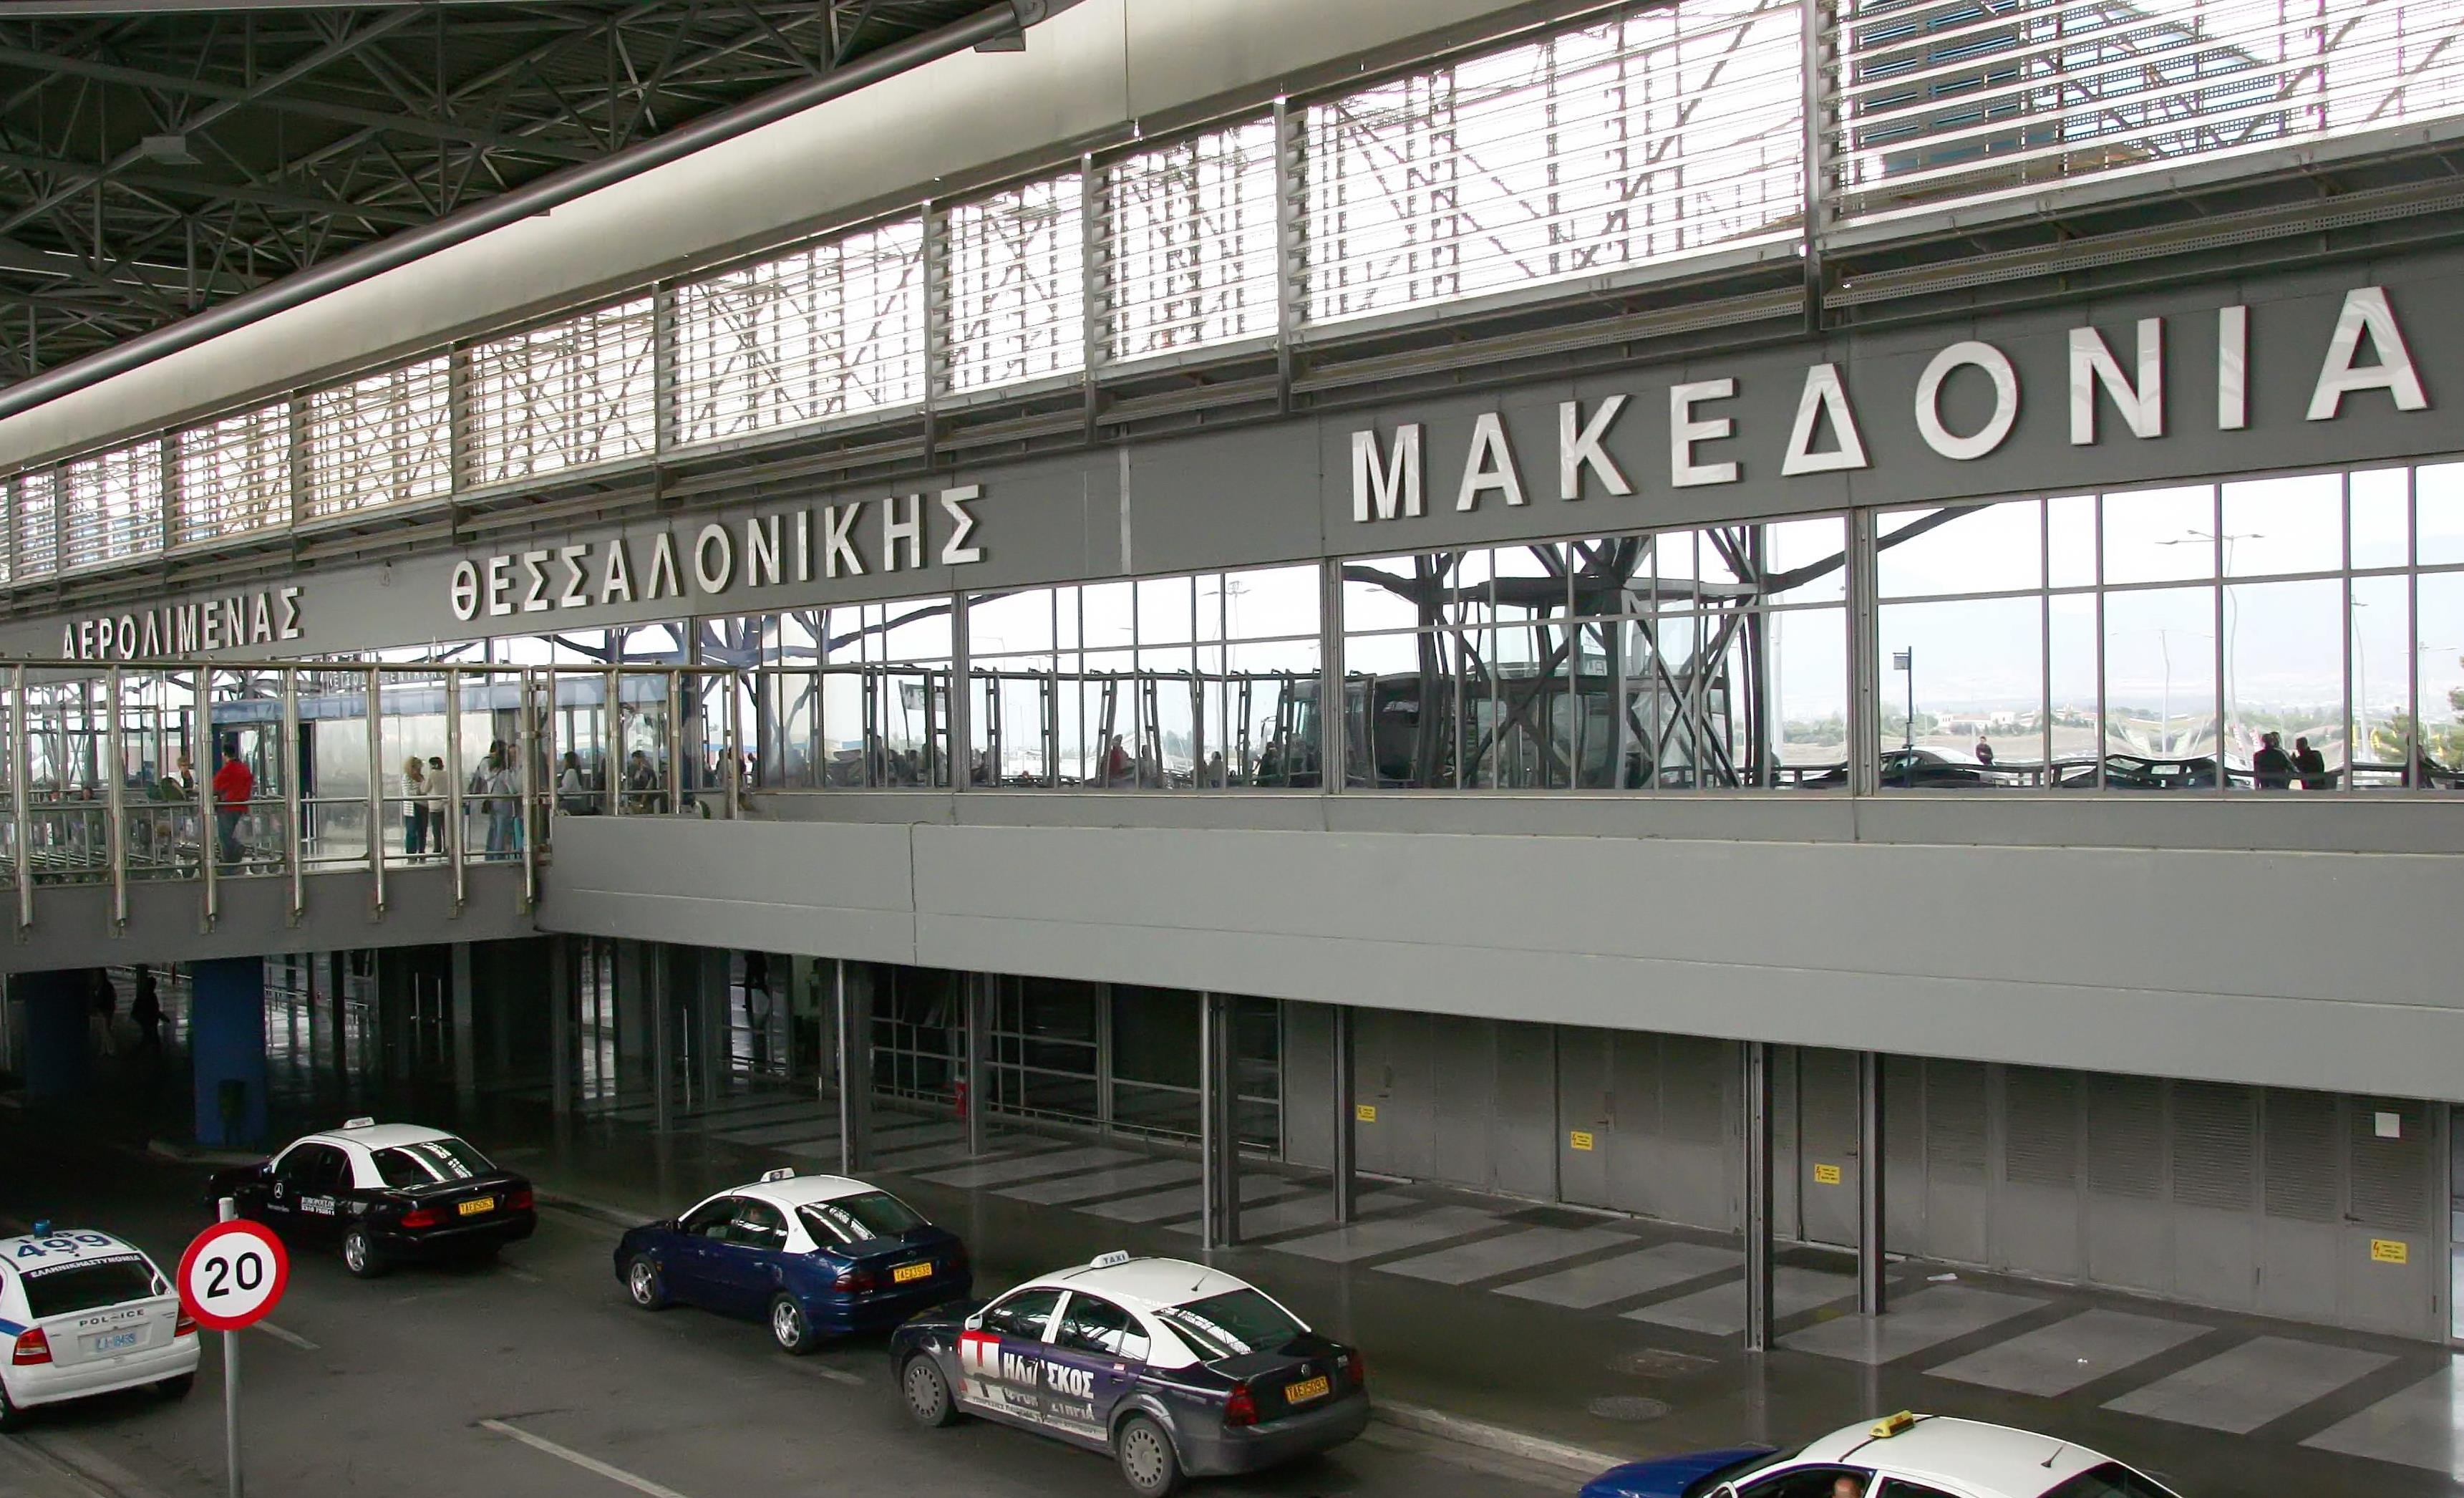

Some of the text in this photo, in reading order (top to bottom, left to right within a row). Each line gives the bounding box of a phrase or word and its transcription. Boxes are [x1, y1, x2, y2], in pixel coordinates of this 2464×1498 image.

[63, 286, 2429, 659] ΑΕΡΟΛΙΜΕΝΑΣ ΘΕΣΣΑΛΟΝΙΚΗΣ ΜΑΚΕΔΟΝΙΑ
[17, 1234, 112, 1257] 499
[1103, 1254, 1125, 1265] TAXI
[205, 1252, 263, 1298] 20
